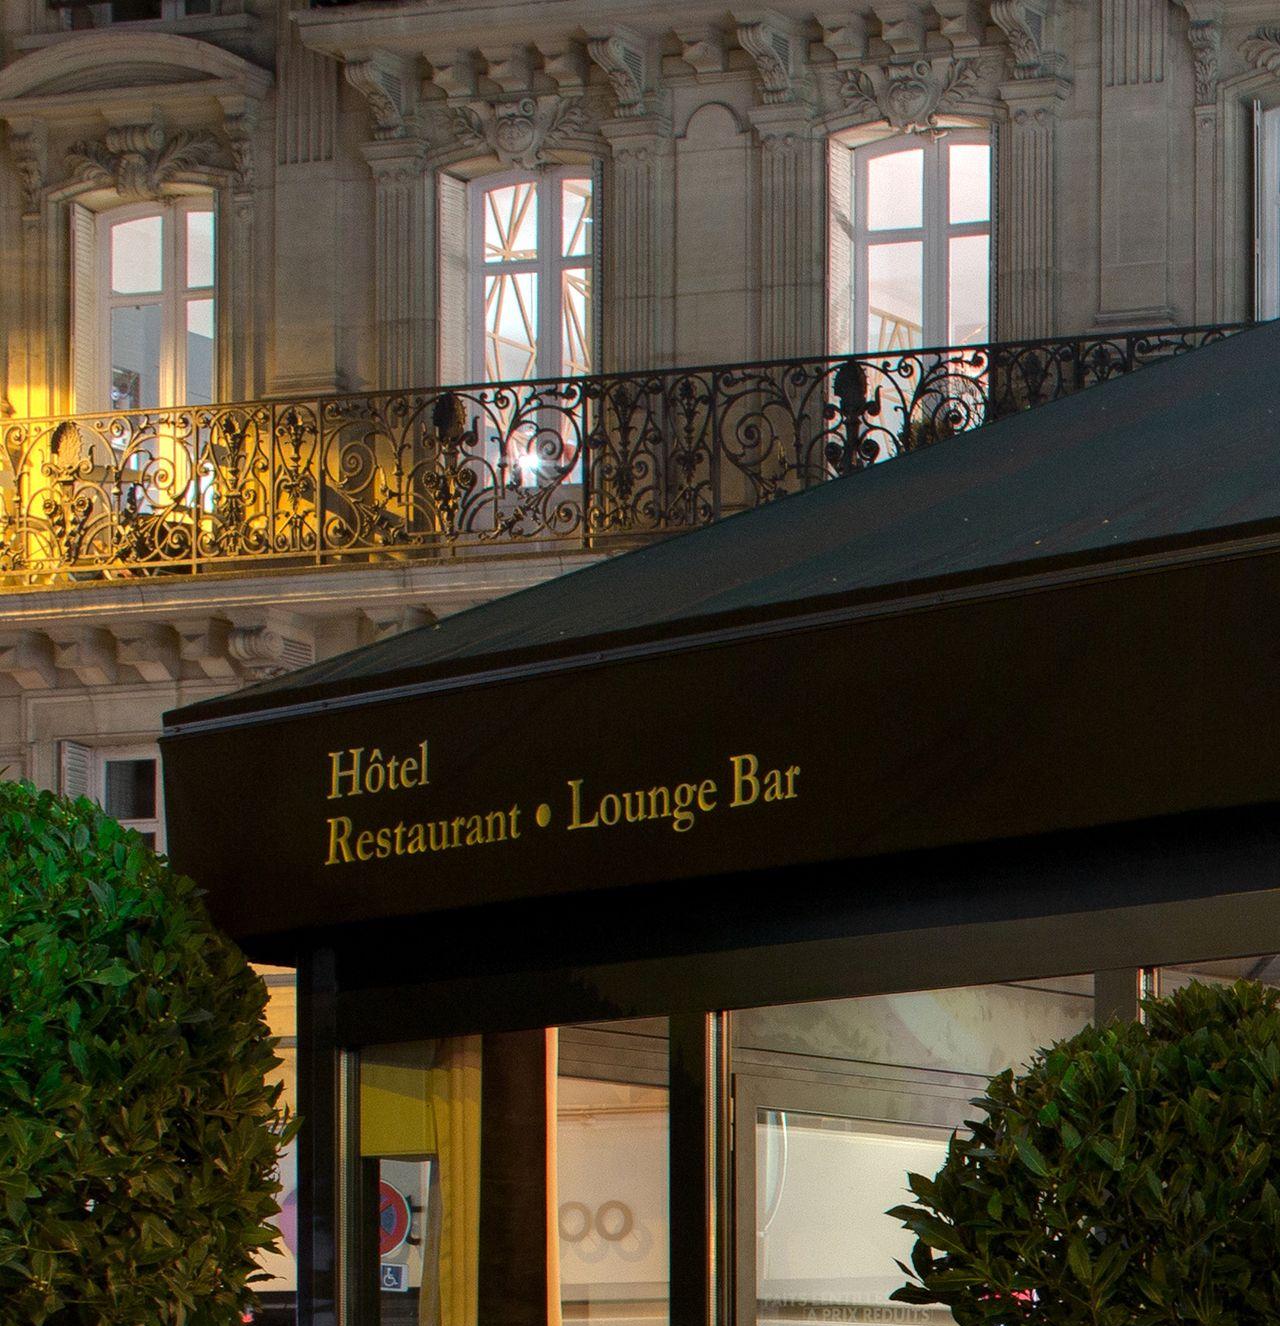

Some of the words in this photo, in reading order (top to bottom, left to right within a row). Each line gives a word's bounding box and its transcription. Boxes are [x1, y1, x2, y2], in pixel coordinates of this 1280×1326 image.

[326, 740, 430, 799] Hôtel
[324, 802, 522, 866] Restaurant
[566, 778, 718, 833] Lounge
[729, 752, 800, 808] Bar
[822, 1307, 857, 1322] PRIX
[863, 1307, 930, 1322] REDUITS
